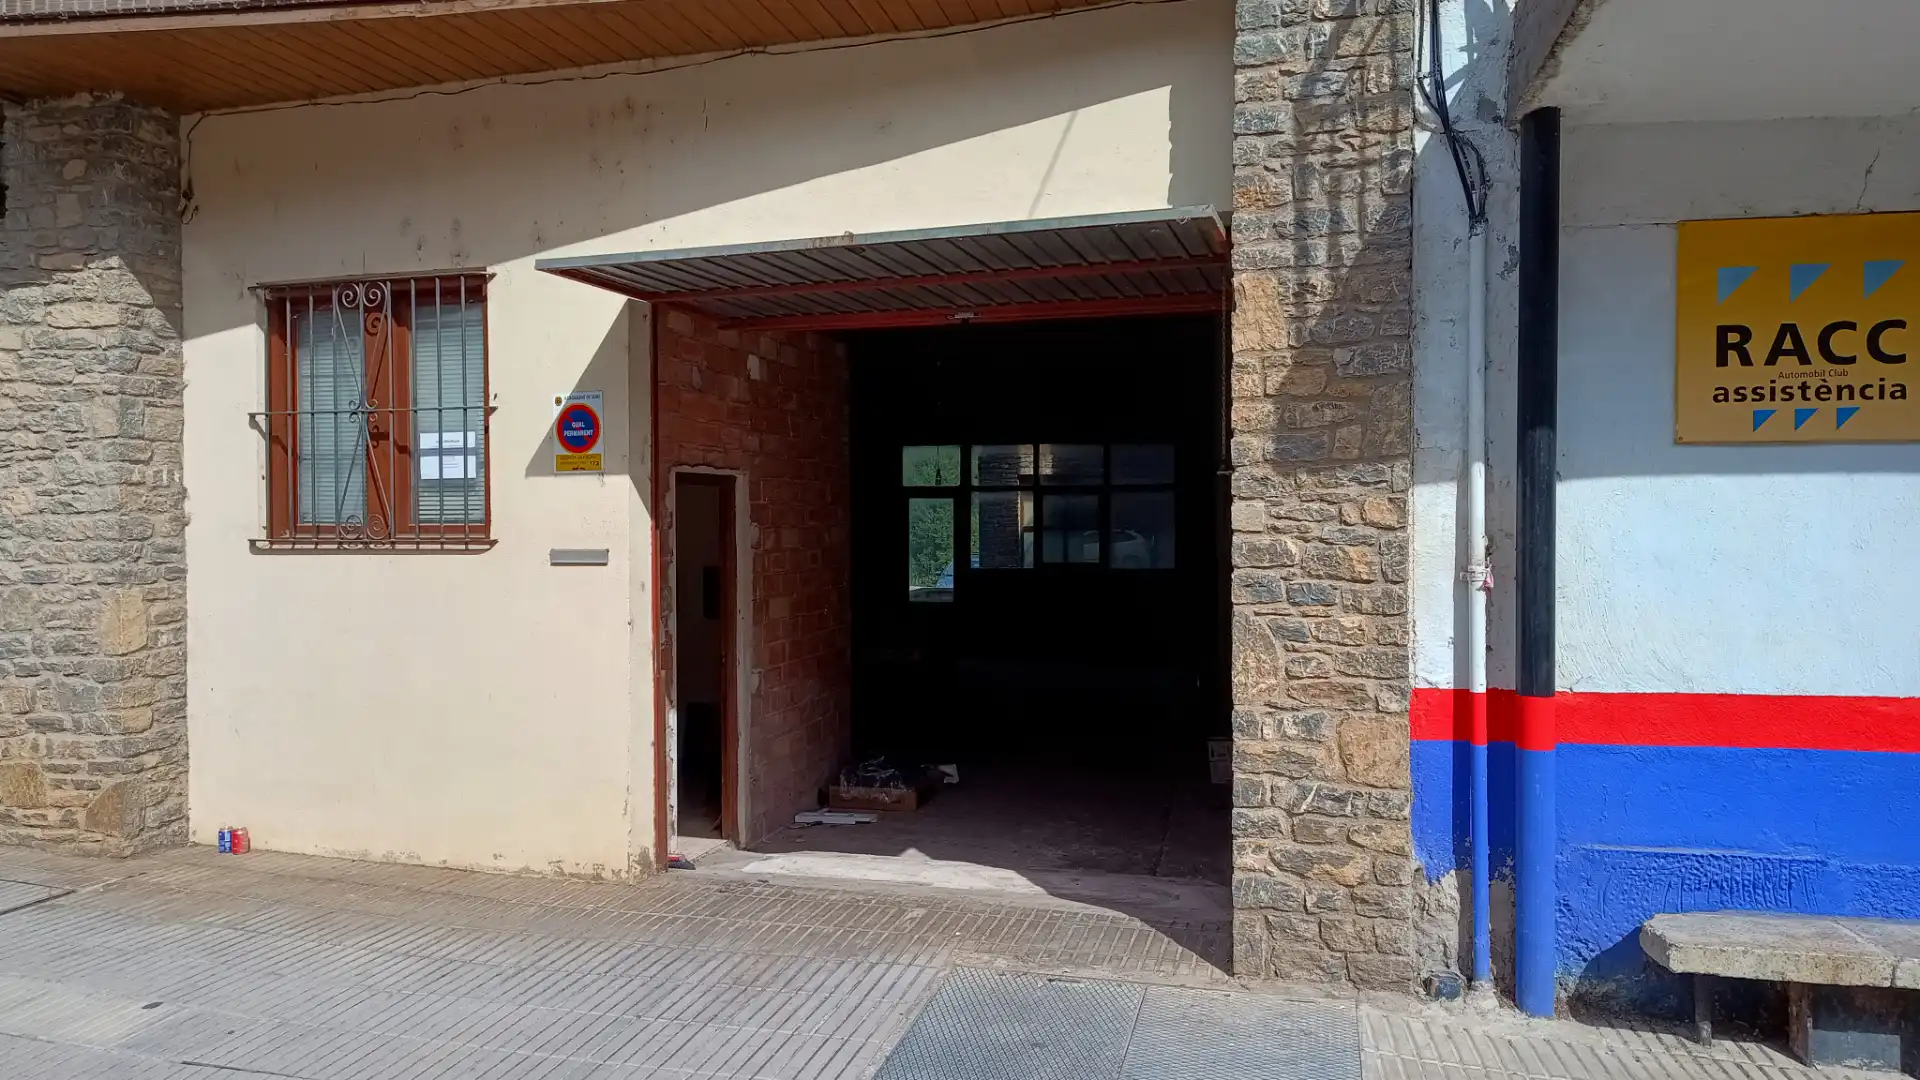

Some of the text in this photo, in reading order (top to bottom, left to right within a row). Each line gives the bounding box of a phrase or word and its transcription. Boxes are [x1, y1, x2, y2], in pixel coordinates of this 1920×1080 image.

[1716, 319, 1908, 368] RACC
[1778, 369, 1849, 379] Automobil Club
[1712, 378, 1908, 403] assistència
